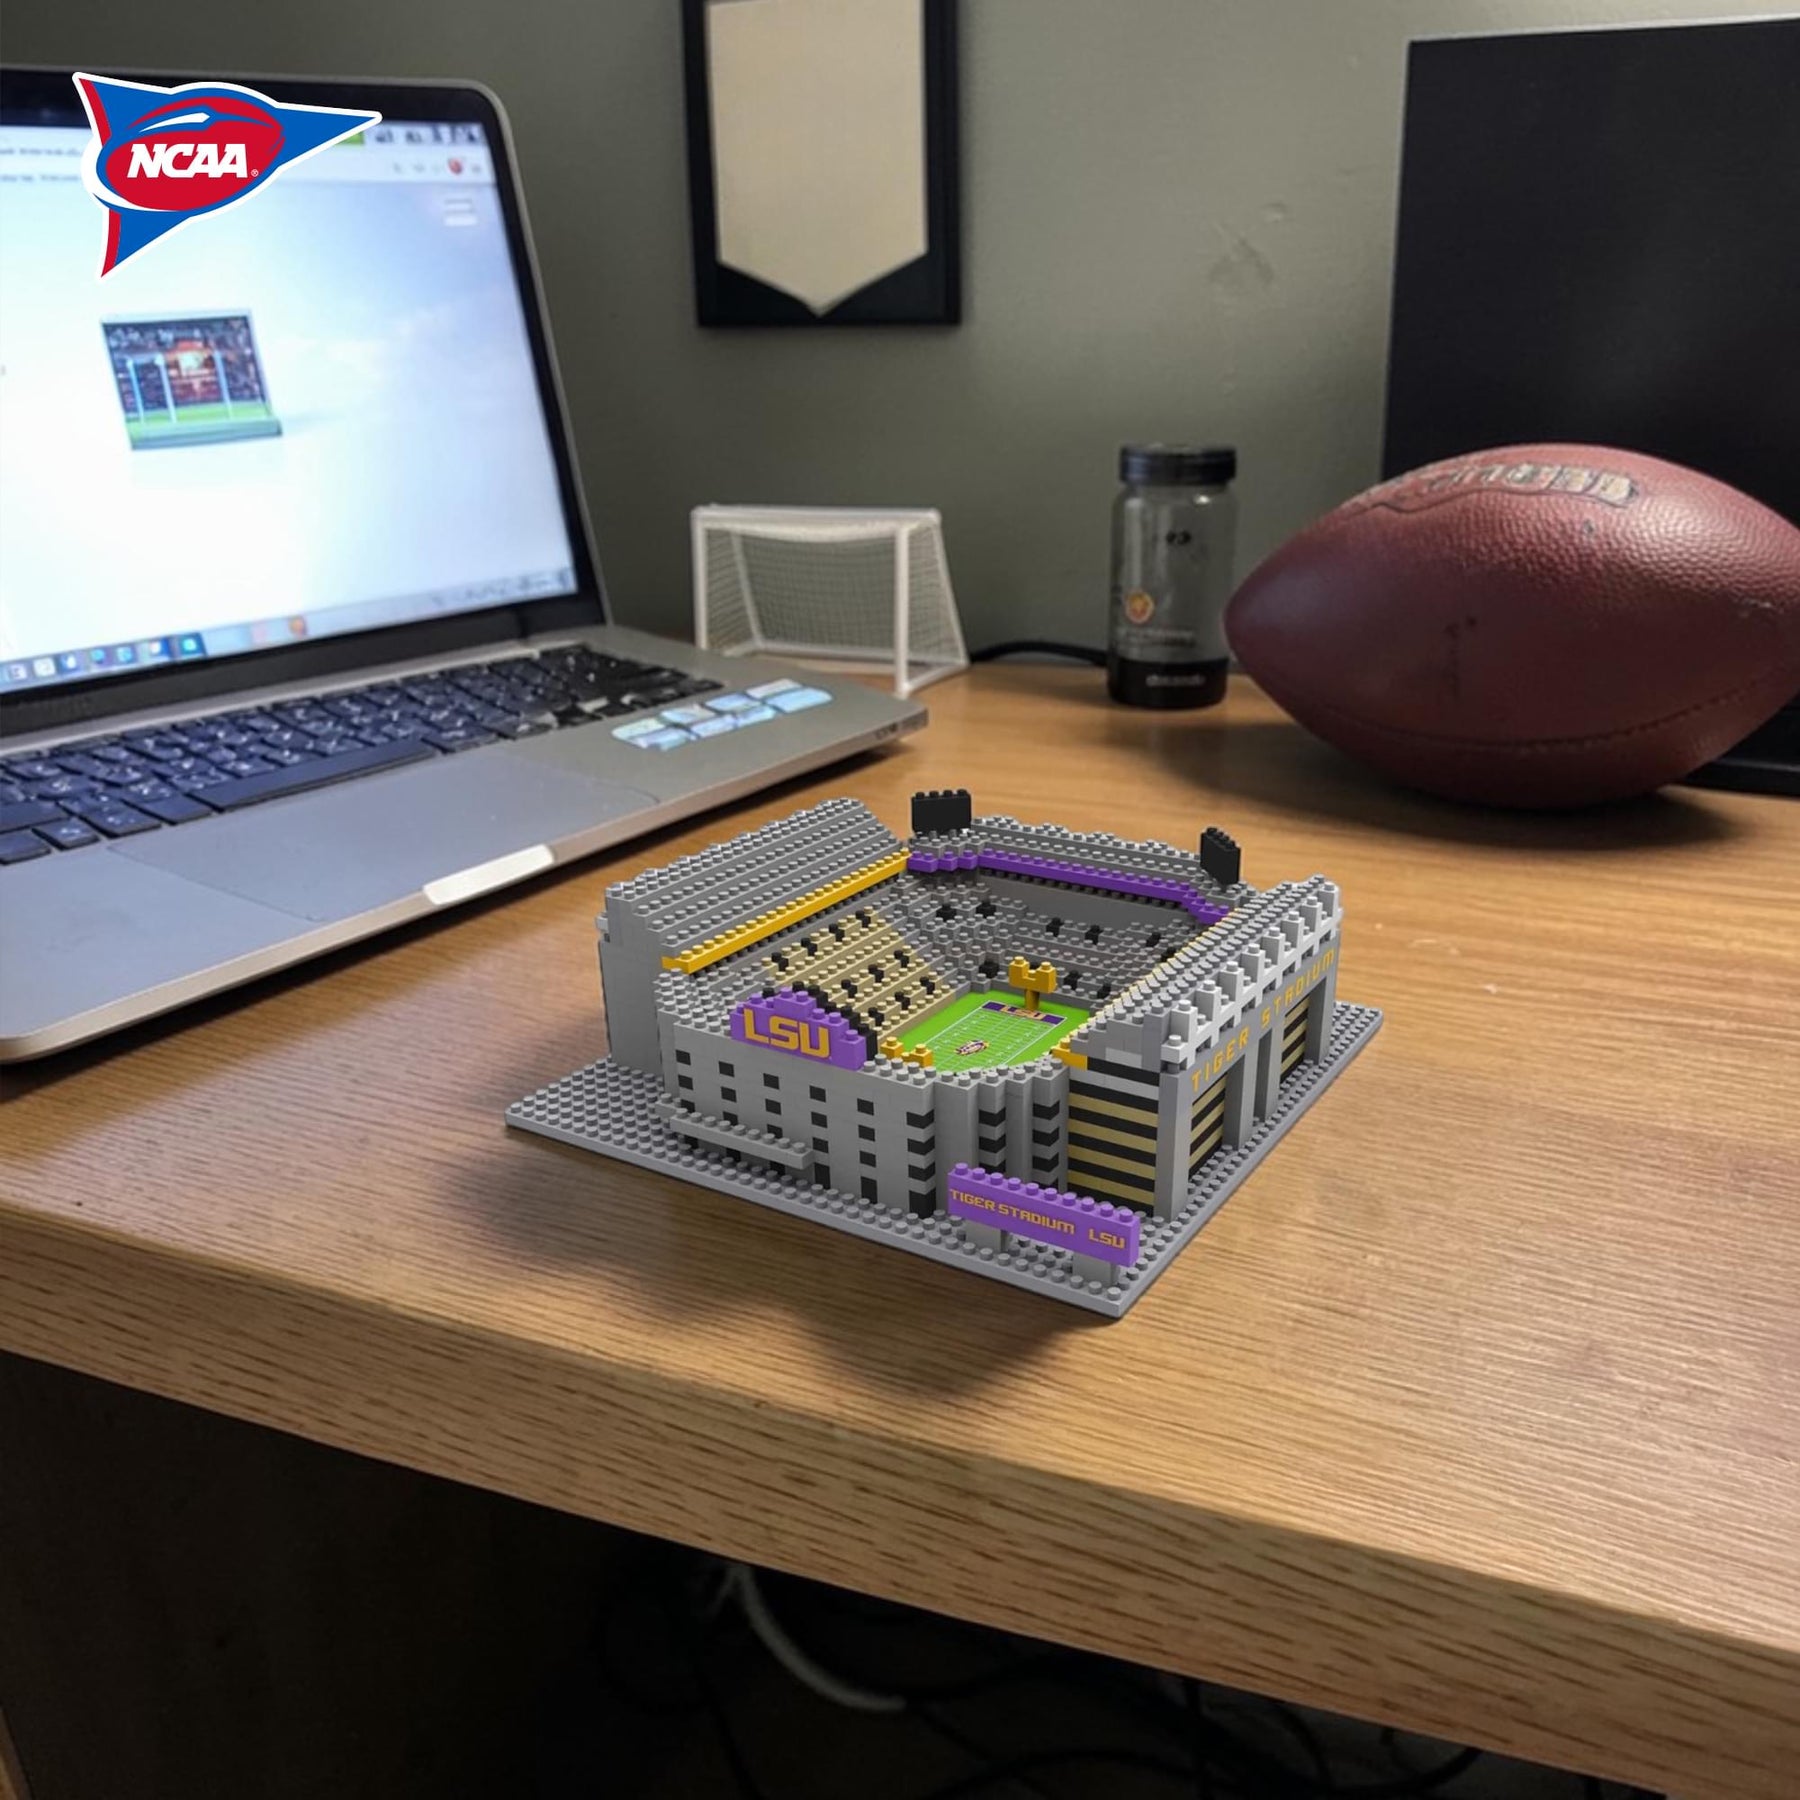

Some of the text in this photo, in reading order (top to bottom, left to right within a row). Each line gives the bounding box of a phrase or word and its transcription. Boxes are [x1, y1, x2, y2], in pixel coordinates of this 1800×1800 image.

[743, 1008, 830, 1058] LSU
[1191, 948, 1335, 1093] TIGER STADIUM
[950, 1188, 1126, 1249] TIGER STADIUM LSU
